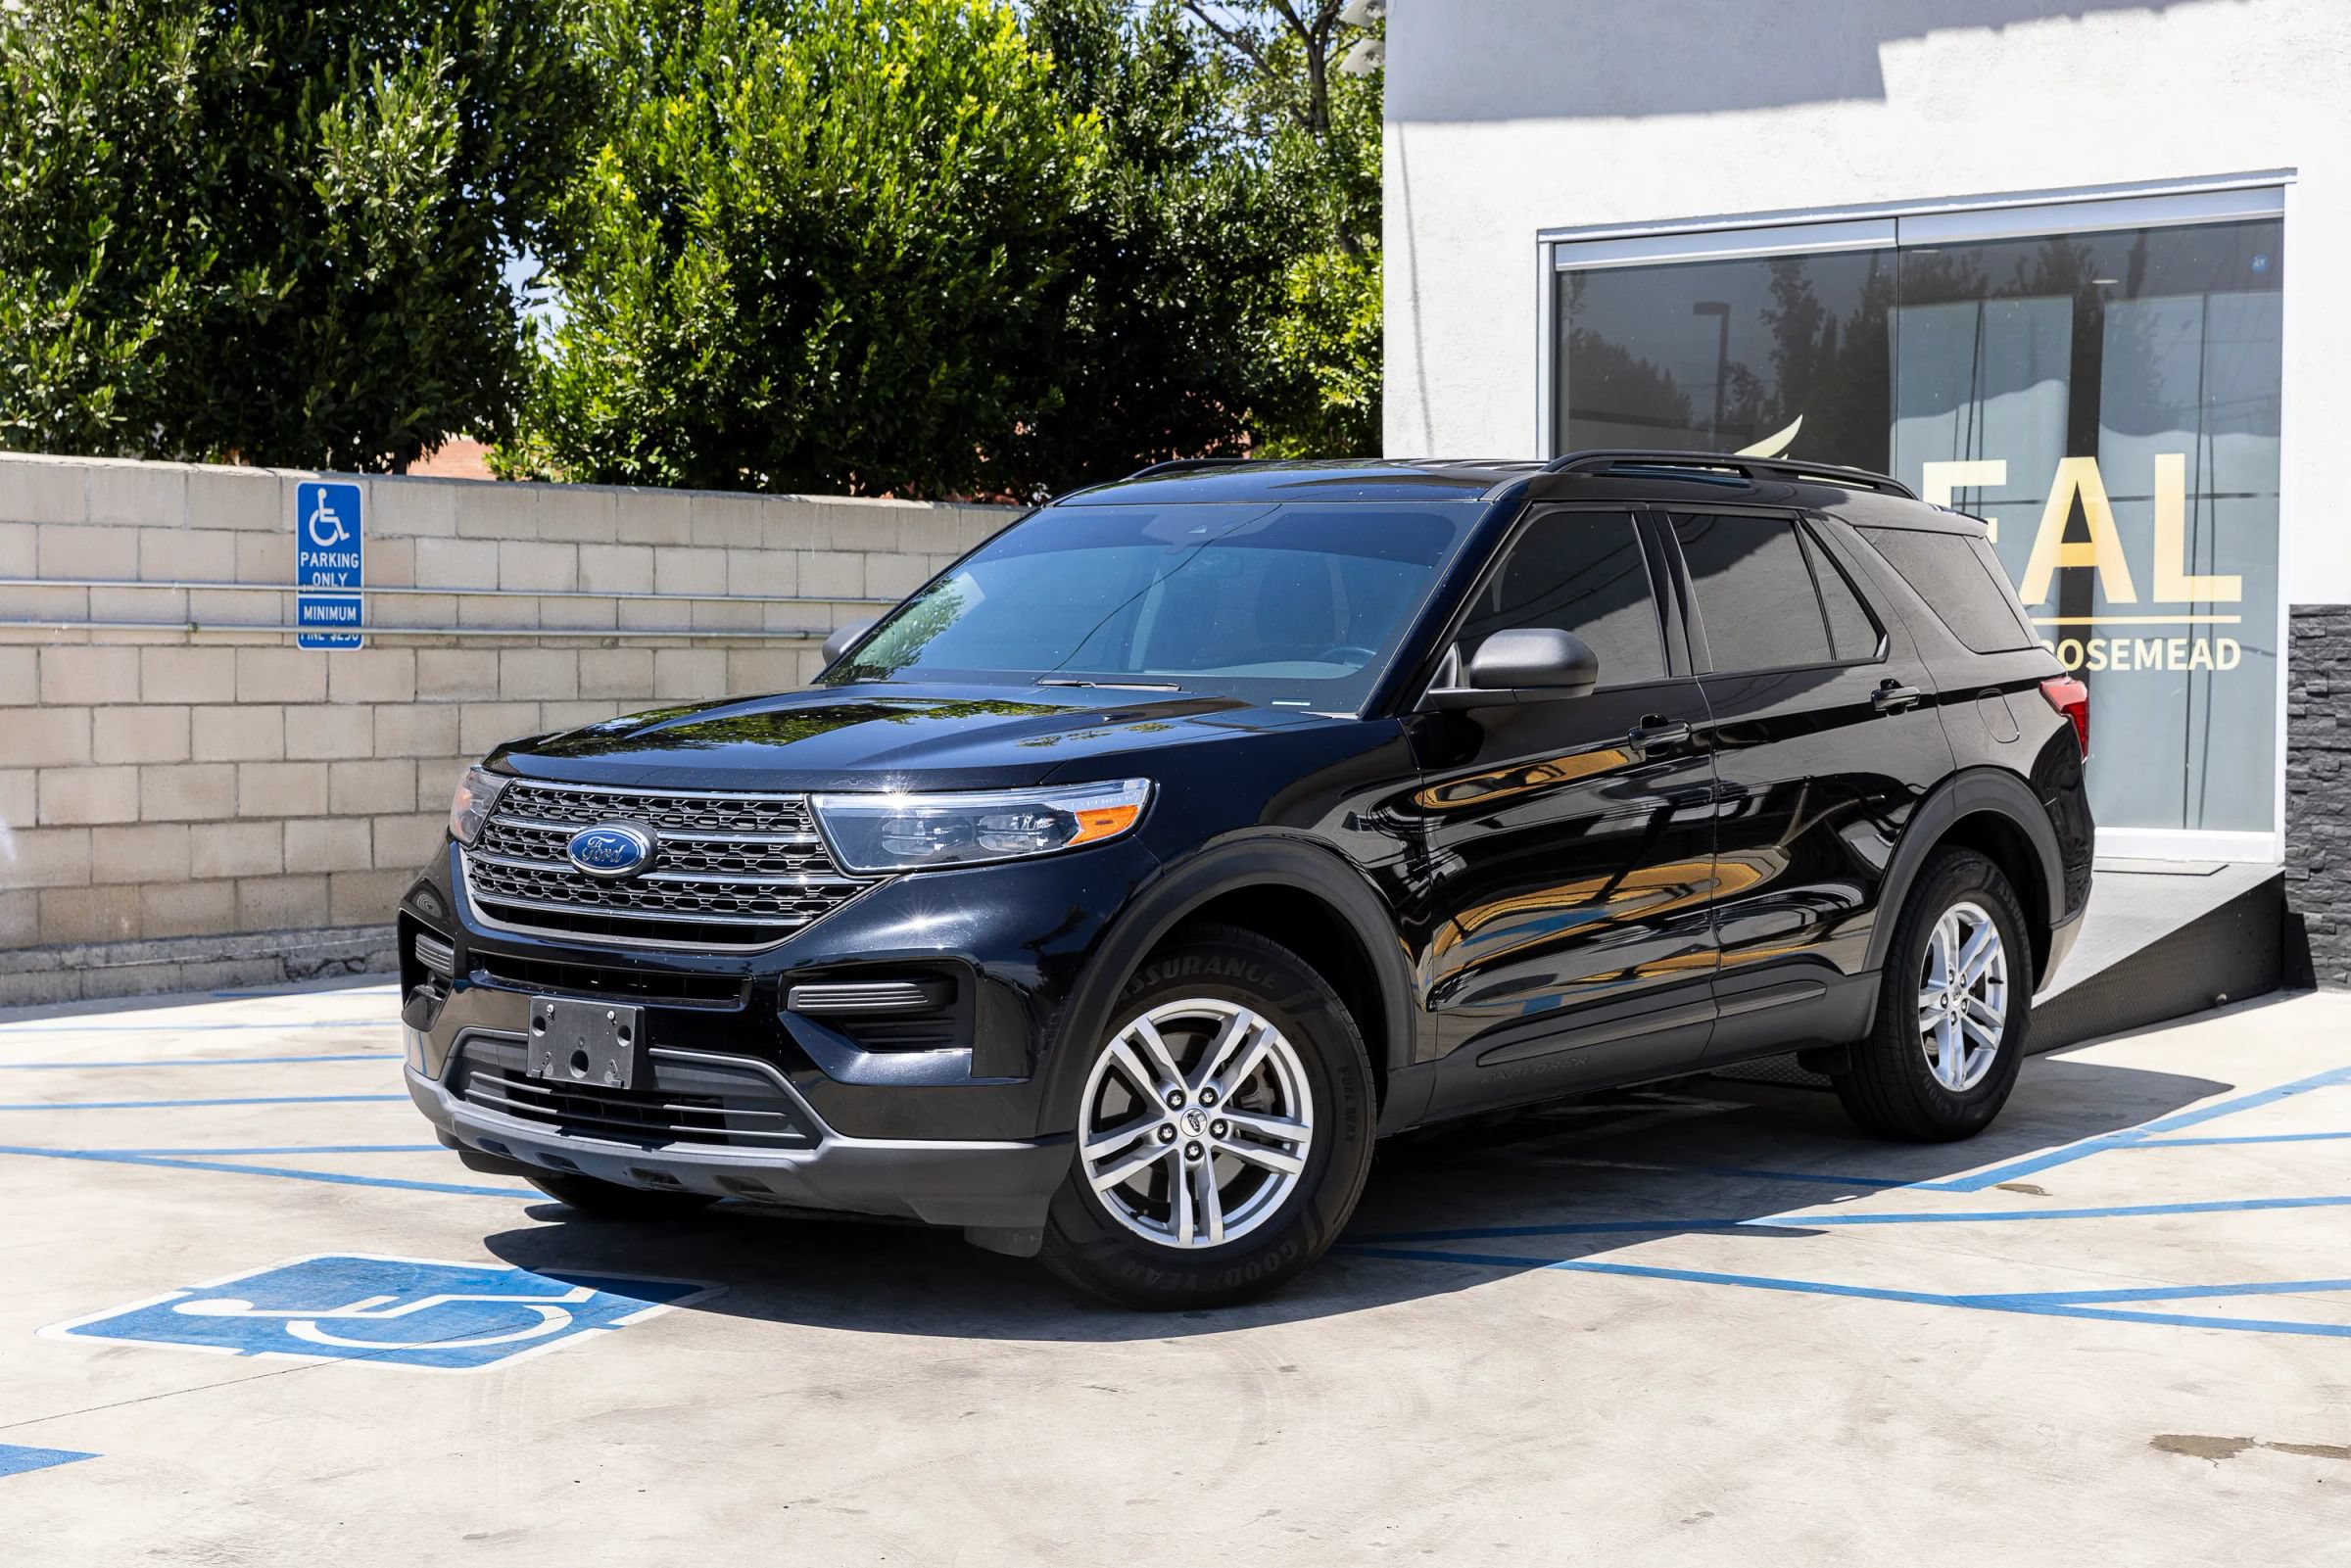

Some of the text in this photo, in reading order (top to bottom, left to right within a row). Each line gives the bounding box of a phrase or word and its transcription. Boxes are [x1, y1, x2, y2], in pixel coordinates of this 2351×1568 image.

[301, 552, 360, 568] PARKING
[312, 571, 348, 588] ONLY
[303, 605, 357, 622] MINIMUM
[582, 835, 627, 864] Ford
